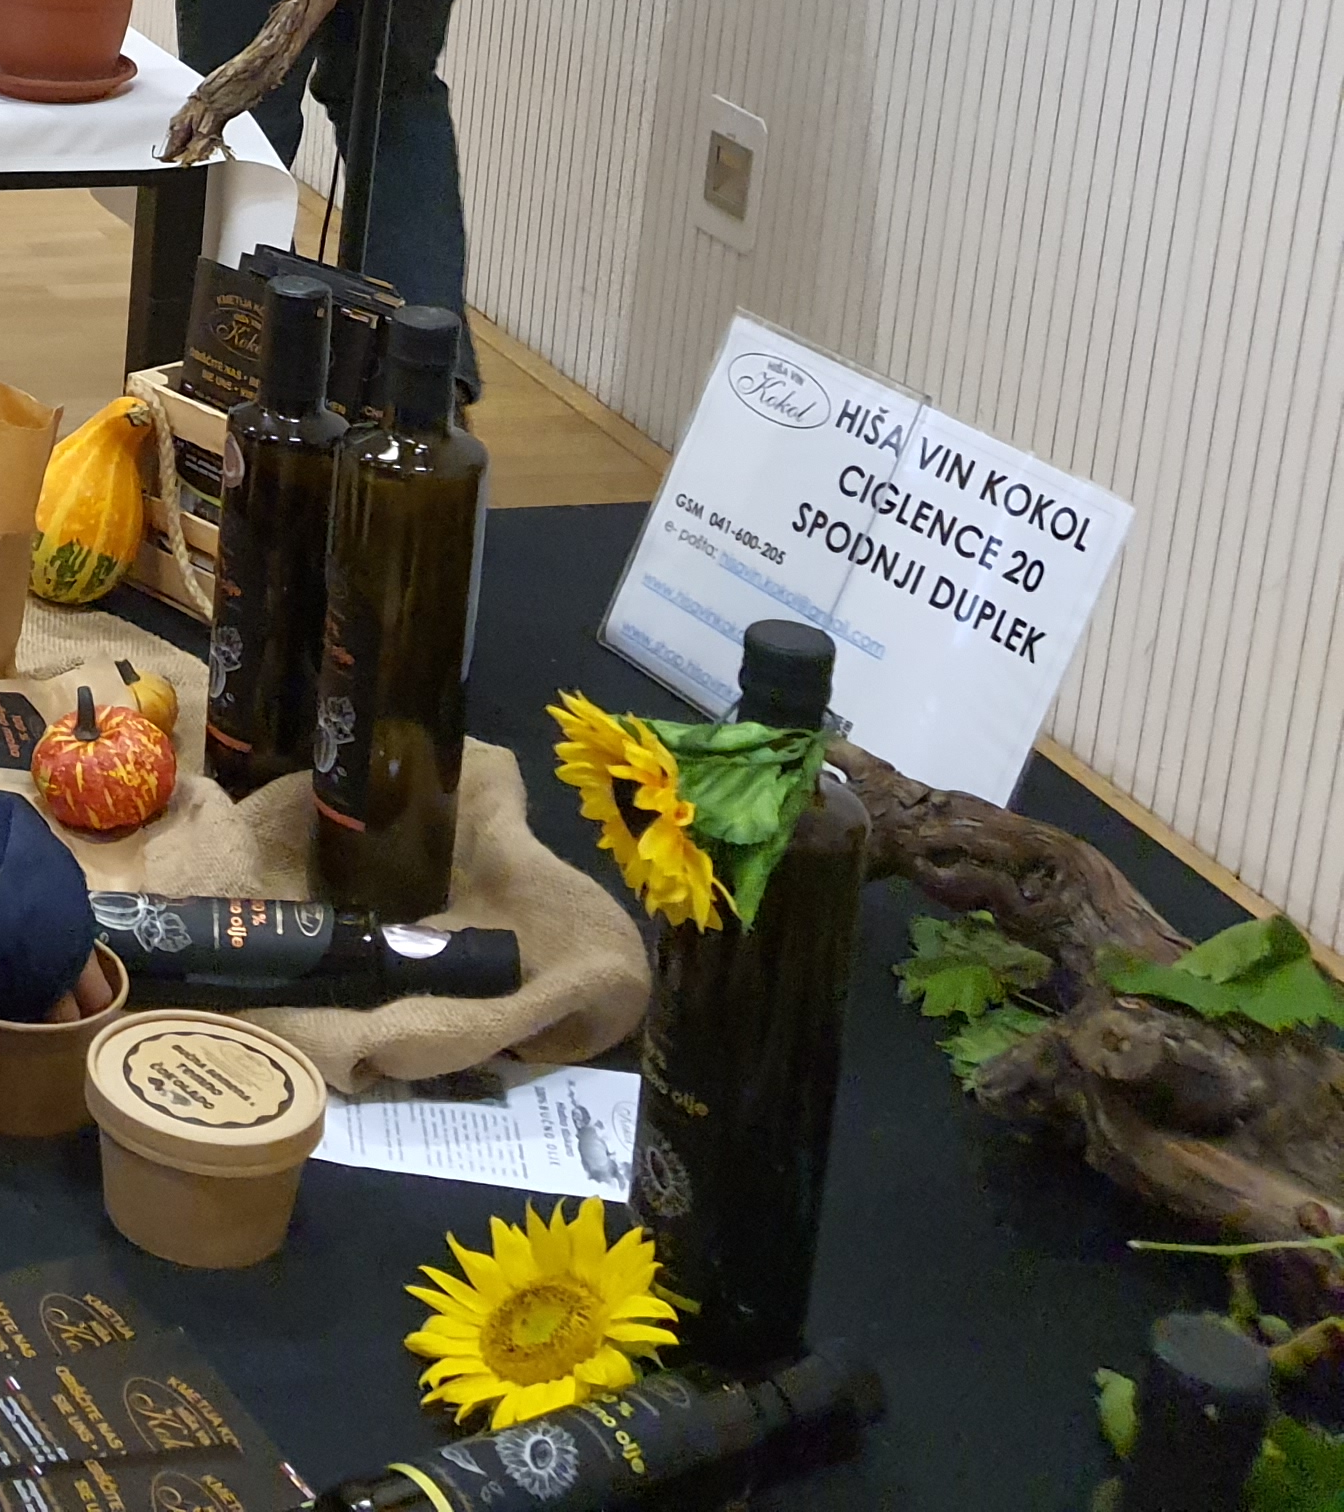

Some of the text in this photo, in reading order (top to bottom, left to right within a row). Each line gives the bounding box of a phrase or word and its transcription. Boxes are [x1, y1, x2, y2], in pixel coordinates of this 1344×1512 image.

[737, 372, 817, 422] Kokol
[675, 493, 787, 565] GSM 041-600-205
[835, 399, 1090, 552] HIŠA VIN KOKOL
[839, 465, 1045, 592] CIGLENCE 20
[792, 502, 1046, 664] SPODNJI DUPLEK
